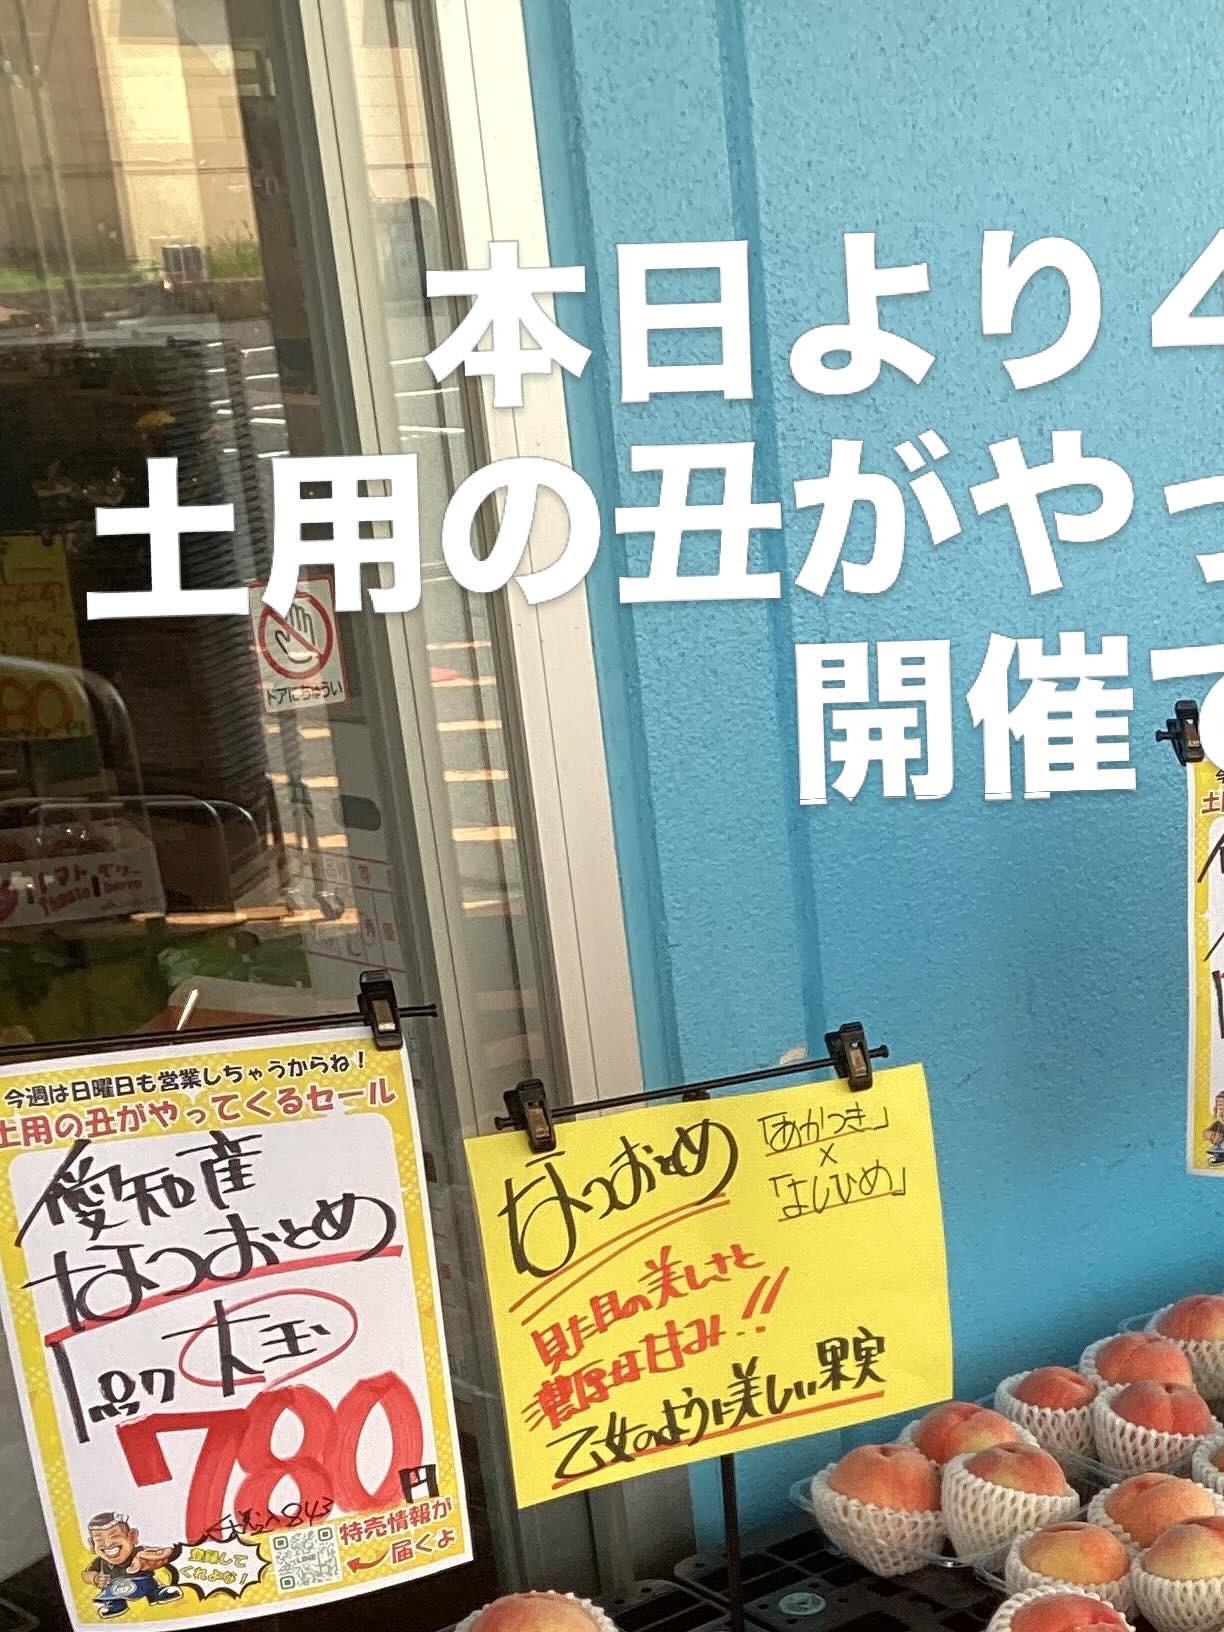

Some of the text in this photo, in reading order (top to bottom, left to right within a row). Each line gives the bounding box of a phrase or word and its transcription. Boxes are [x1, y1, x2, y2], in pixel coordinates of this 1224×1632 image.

[0, 1077, 396, 1147] 土用の丑がやってくるセール
[3, 1051, 366, 1109] 今週は日曜日も営業しちゃうからね！
[14, 1130, 263, 1247] 愛知産
[498, 1118, 739, 1278] なつおとめ
[22, 1193, 397, 1332] なつおとめ
[531, 1243, 766, 1375] 見た目の美しさと
[161, 1300, 331, 1397] 大玉
[546, 1325, 887, 1480] 乙女のように美しい果実
[339, 1497, 453, 1545] 特売情報が
[391, 1532, 455, 1564] 届くよ
